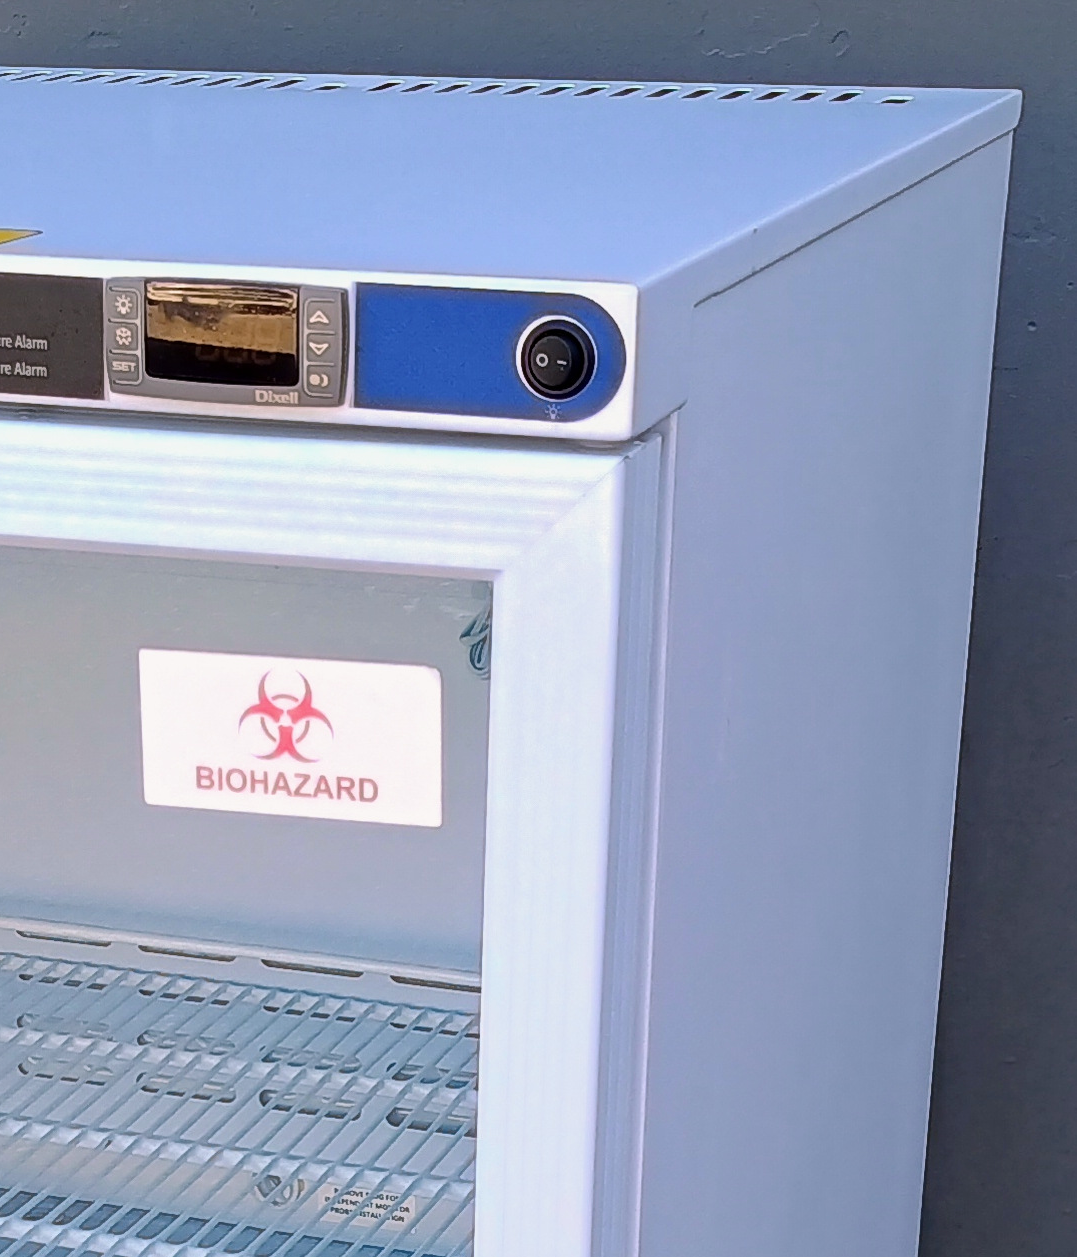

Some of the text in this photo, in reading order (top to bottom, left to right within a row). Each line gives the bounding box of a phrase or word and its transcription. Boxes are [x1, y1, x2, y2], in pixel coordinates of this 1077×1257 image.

[15, 334, 48, 350] Alarm
[14, 362, 48, 378] Alarm
[111, 361, 137, 372] SET
[255, 390, 299, 404] Dixell
[195, 765, 379, 803] BIOHAZARD
